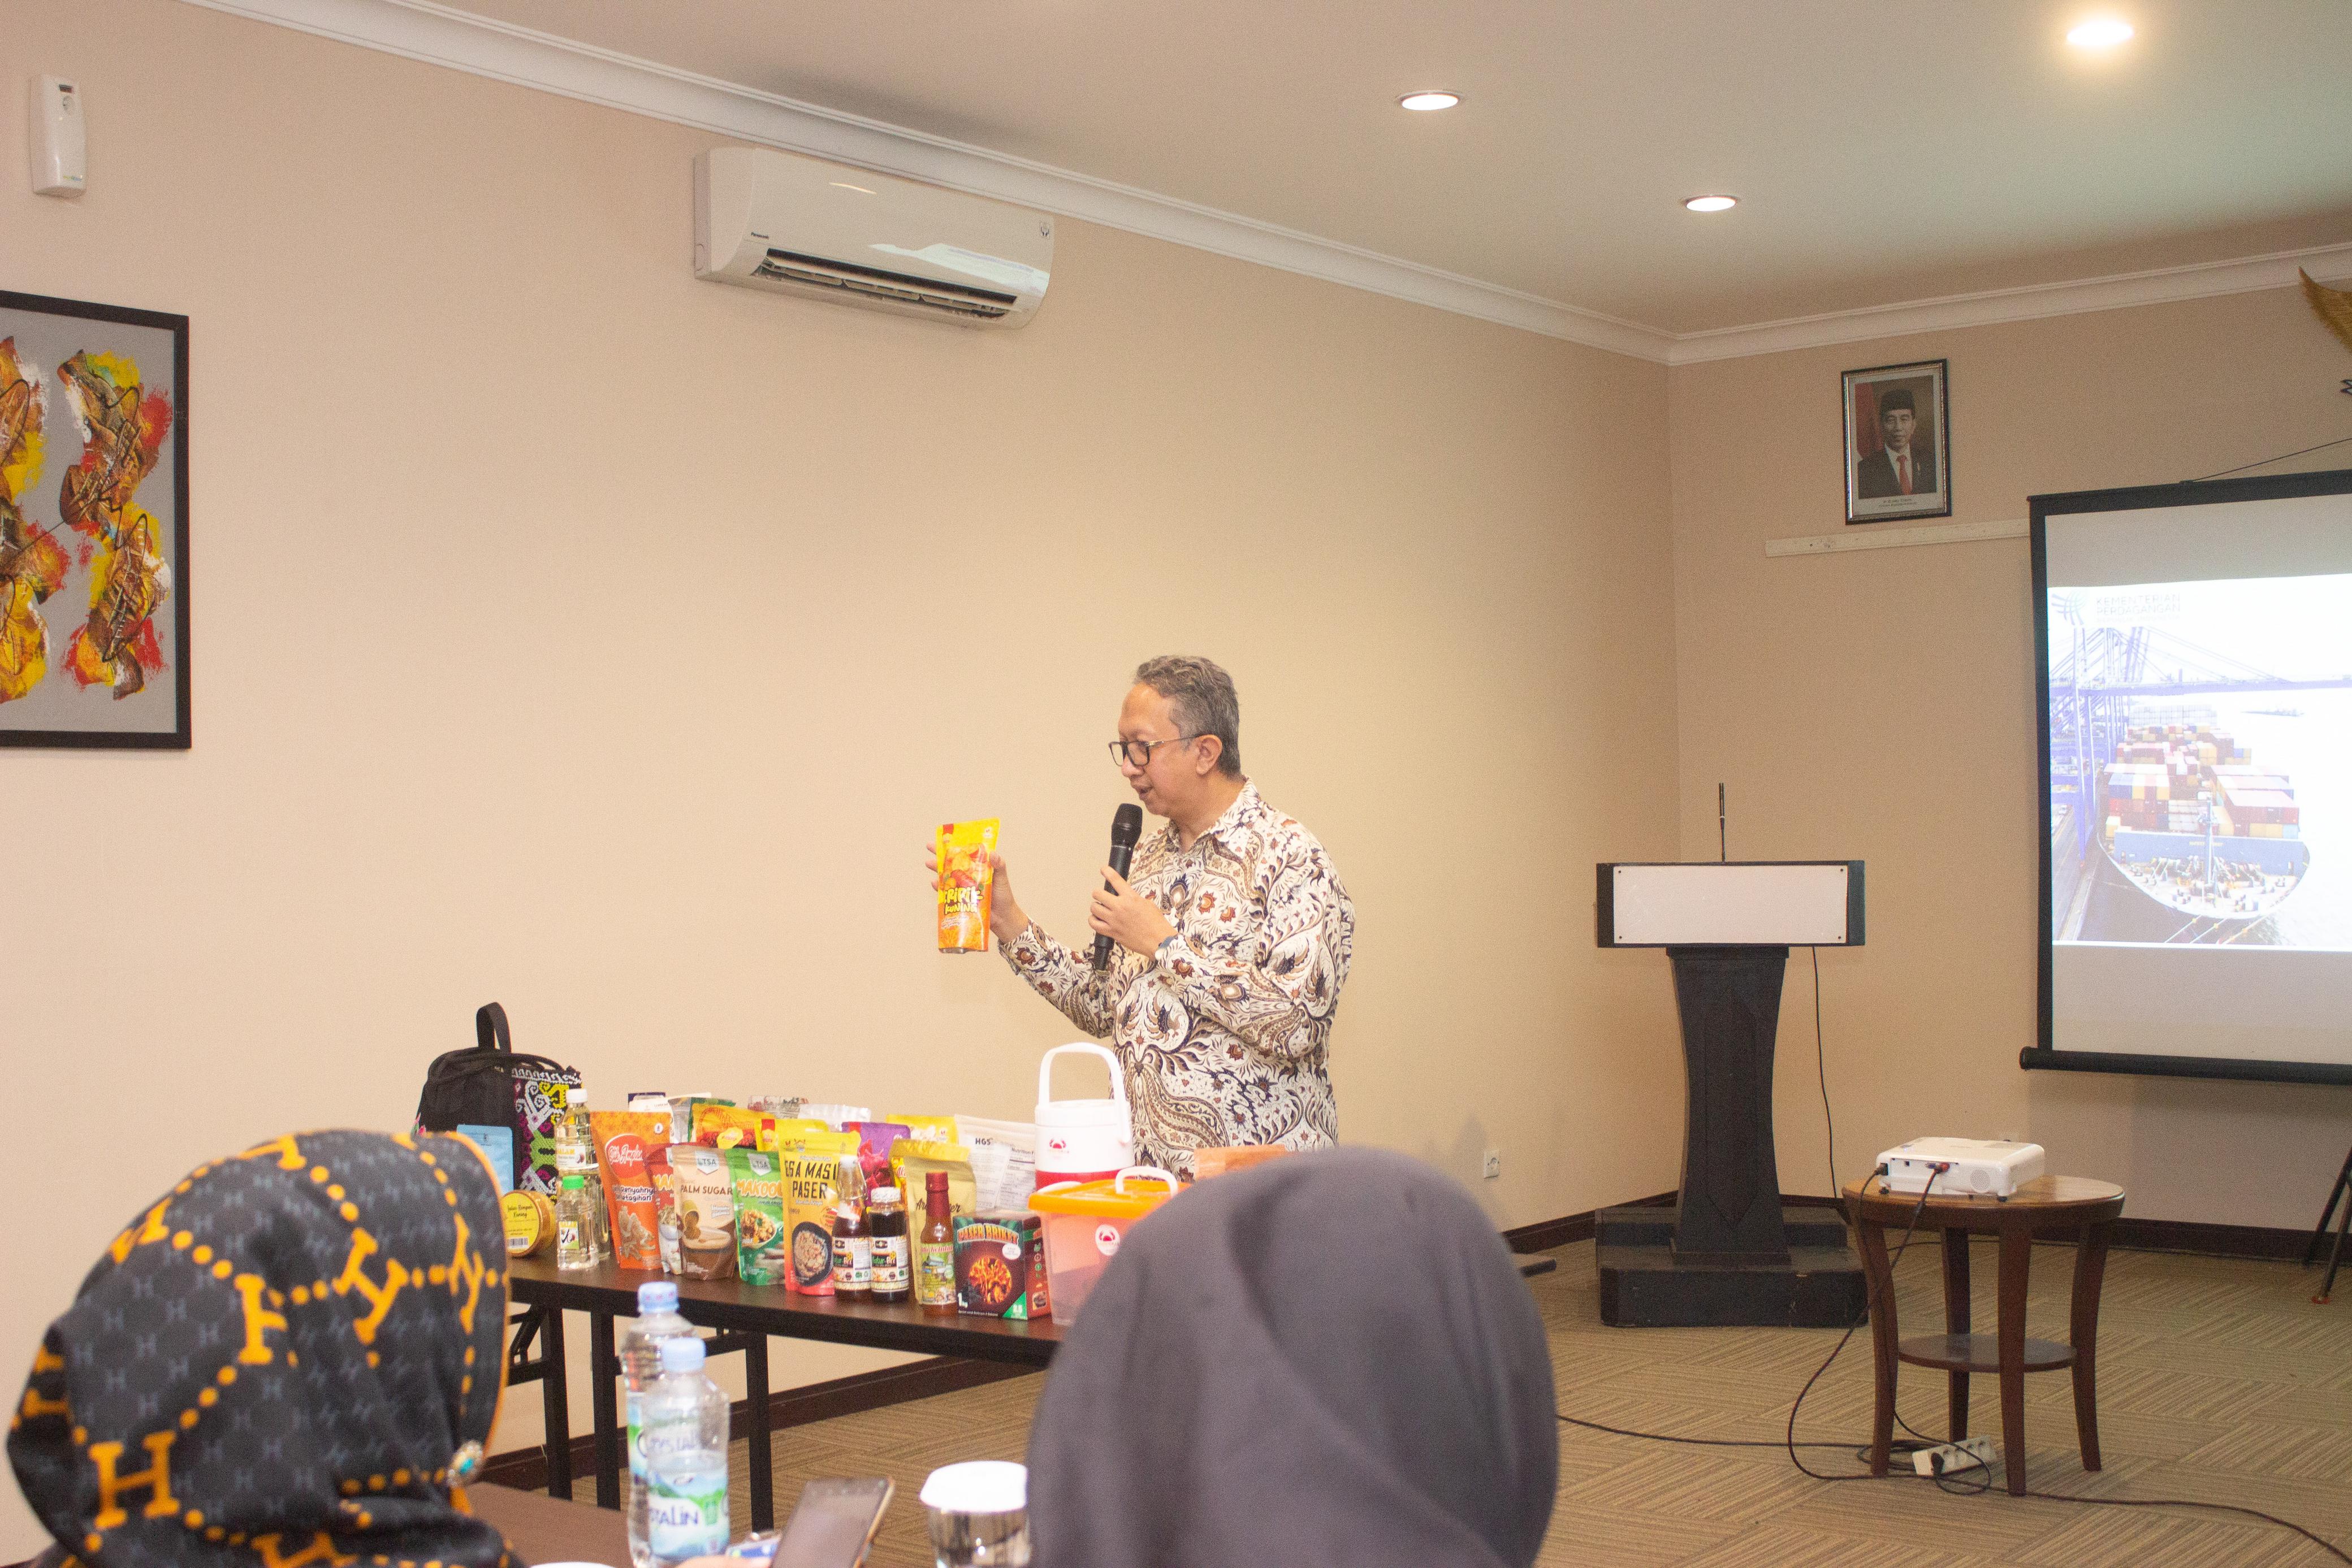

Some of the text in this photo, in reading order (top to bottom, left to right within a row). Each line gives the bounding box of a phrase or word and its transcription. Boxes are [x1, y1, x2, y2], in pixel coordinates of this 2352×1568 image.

[2096, 594, 2181, 606] KEMENTERIAN
[2096, 604, 2181, 616] PERDAGANGAN
[681, 1184, 733, 1195] PALM SUGAR
[793, 1181, 828, 1199] PASER
